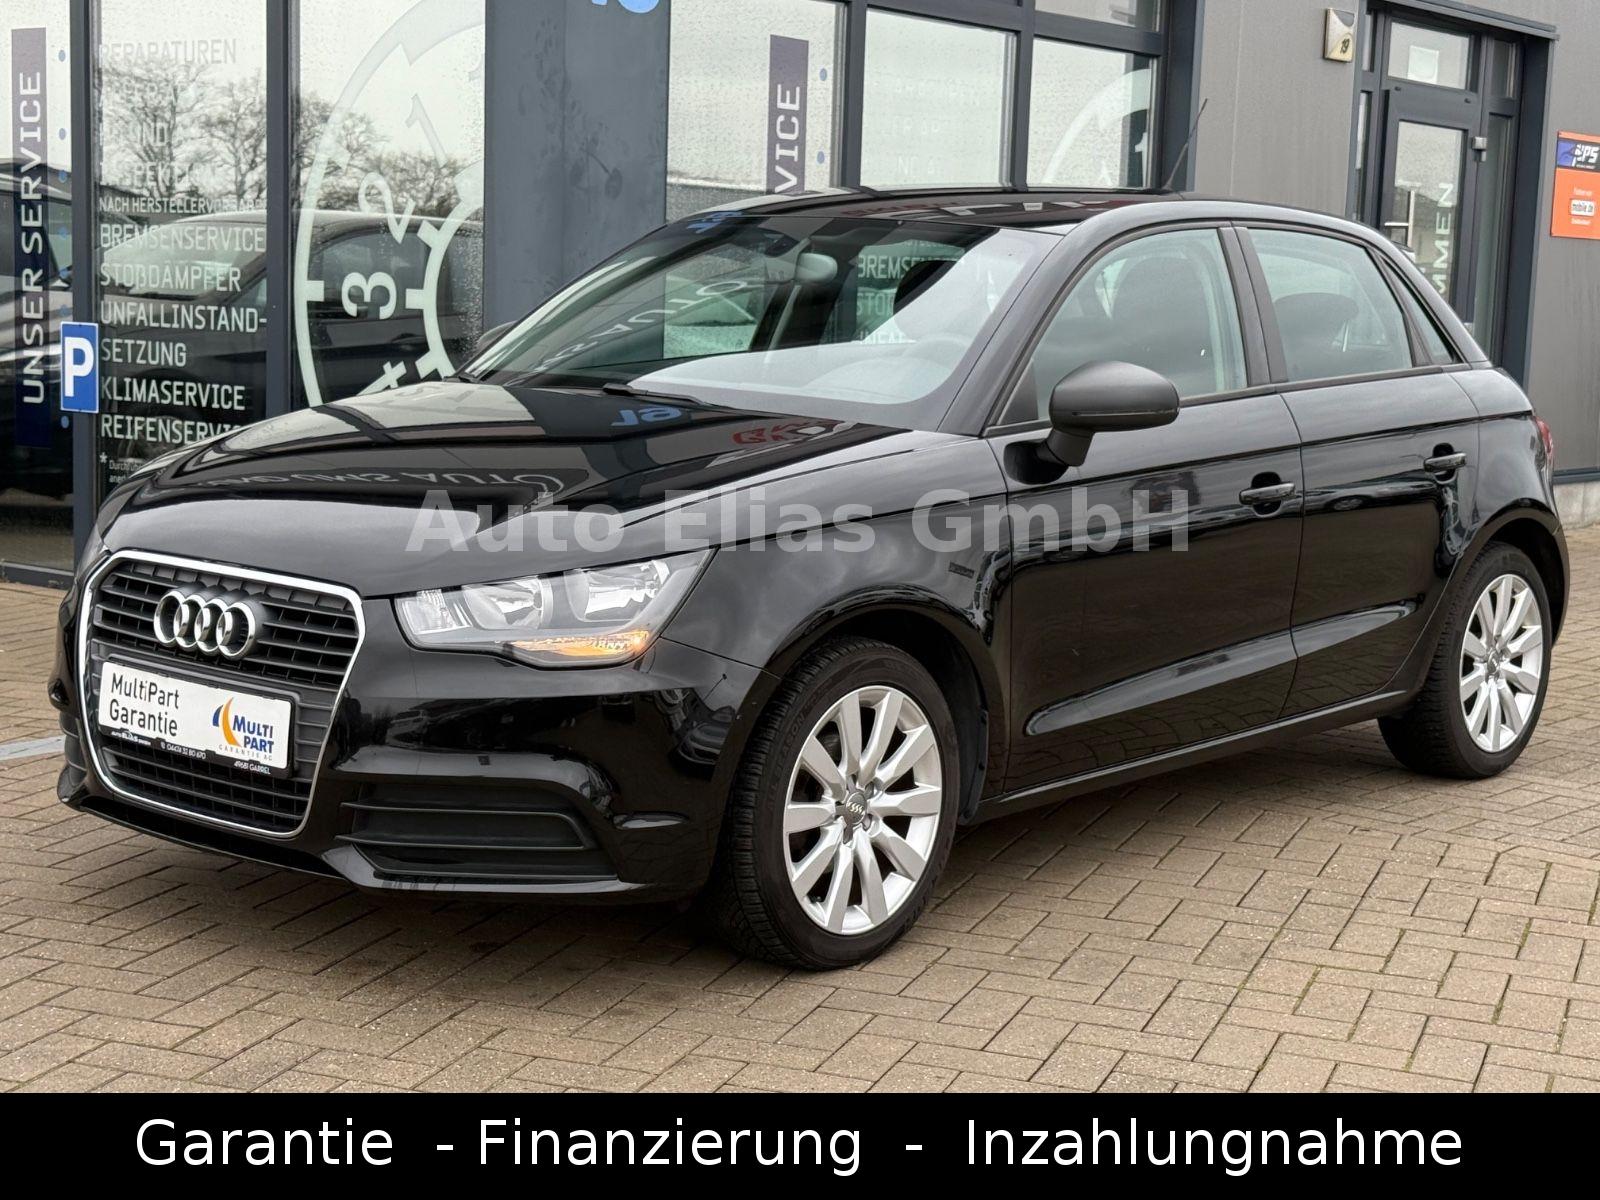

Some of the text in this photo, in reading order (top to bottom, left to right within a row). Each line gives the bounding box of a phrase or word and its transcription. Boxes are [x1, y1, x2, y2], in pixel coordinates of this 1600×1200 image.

[774, 83, 801, 193] VICE
[99, 197, 130, 212] NACH
[19, 71, 45, 404] UNSER SERVICE
[100, 223, 266, 252] BREMSENSERVICE
[1431, 182, 1454, 294] MMEN
[341, 271, 397, 320] 3
[101, 301, 267, 333] UNFALLINSTAND-
[64, 336, 94, 397] P
[101, 338, 187, 368] SETZUNG
[101, 376, 246, 411] KLIMASERVICE
[101, 415, 242, 446] REIFENSERV
[111, 672, 180, 710] MultiPart
[109, 698, 178, 737] Garantie
[232, 714, 274, 739] MULTI
[243, 735, 275, 754] PART
